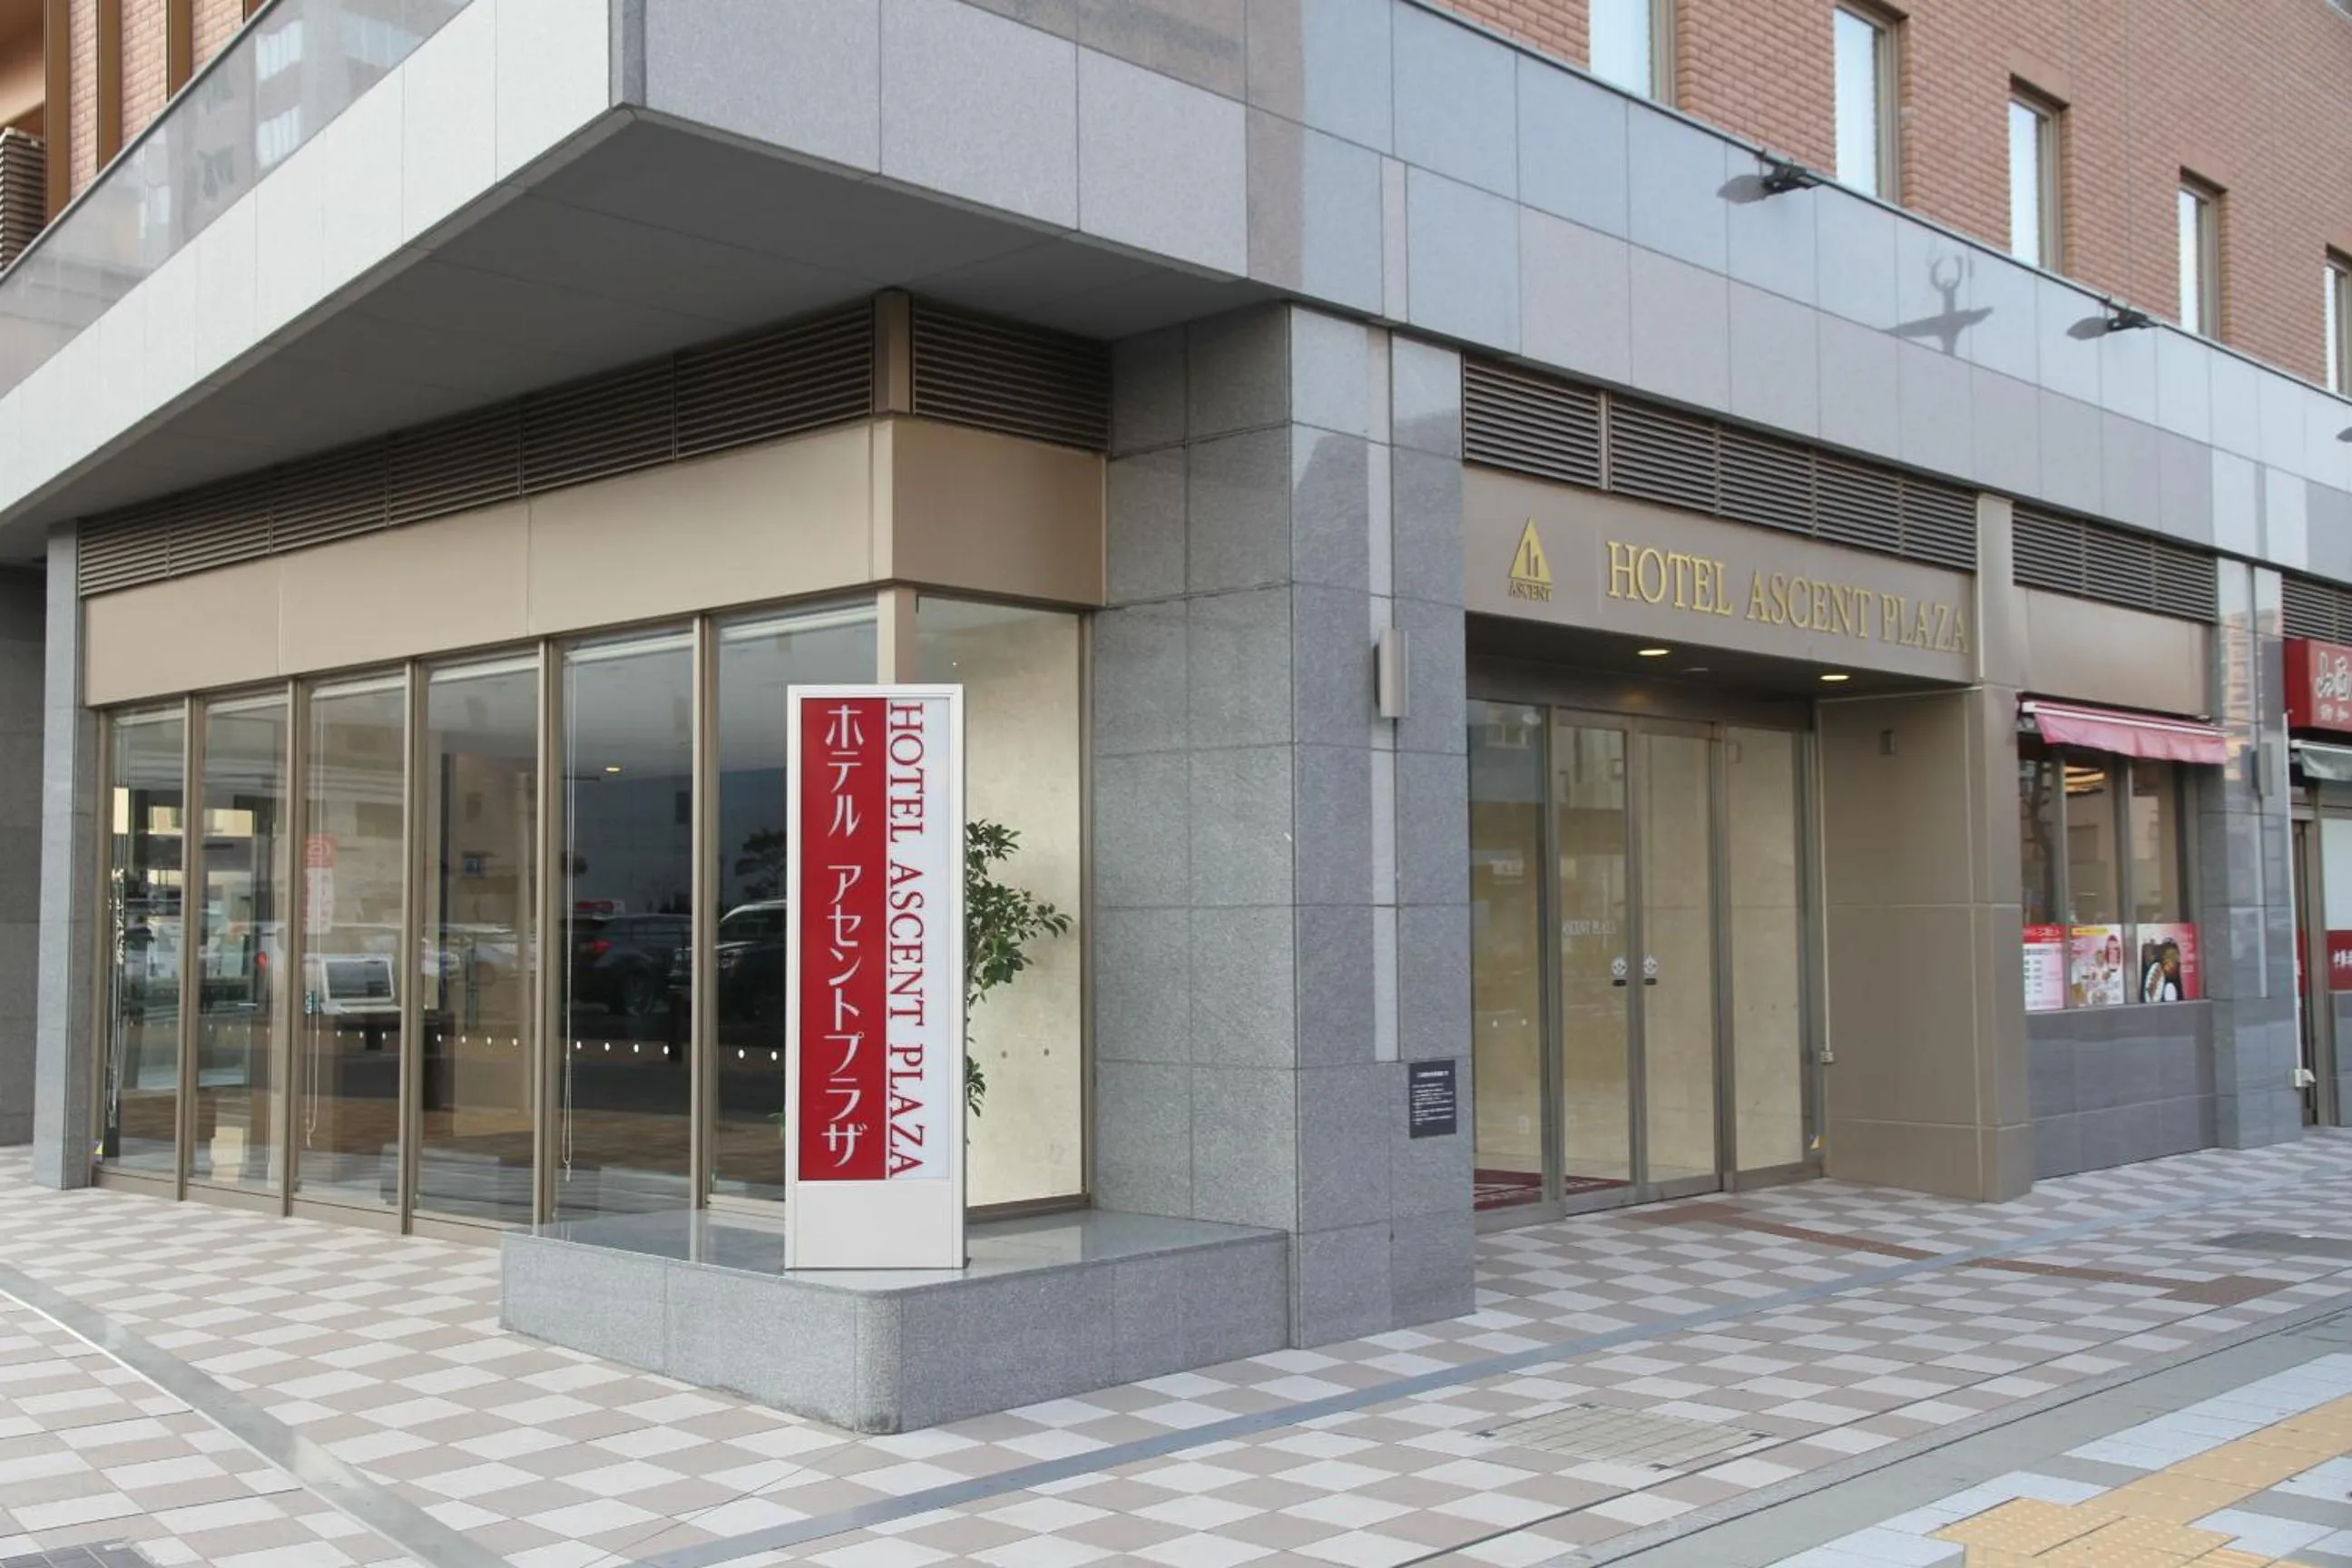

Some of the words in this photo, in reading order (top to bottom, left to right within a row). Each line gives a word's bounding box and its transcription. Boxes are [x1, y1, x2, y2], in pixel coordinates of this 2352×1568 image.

[1508, 580, 1551, 603] ASCENT
[1607, 541, 1732, 616] HOTEL
[1745, 569, 1871, 638] ASCENT
[1879, 593, 1969, 653] PLAZA
[825, 704, 865, 838] ホテル
[889, 702, 925, 843] HOTEL
[889, 861, 925, 1026] ASCENT
[821, 865, 867, 1168] アセントプラザ
[889, 1044, 925, 1179] PLAZA
